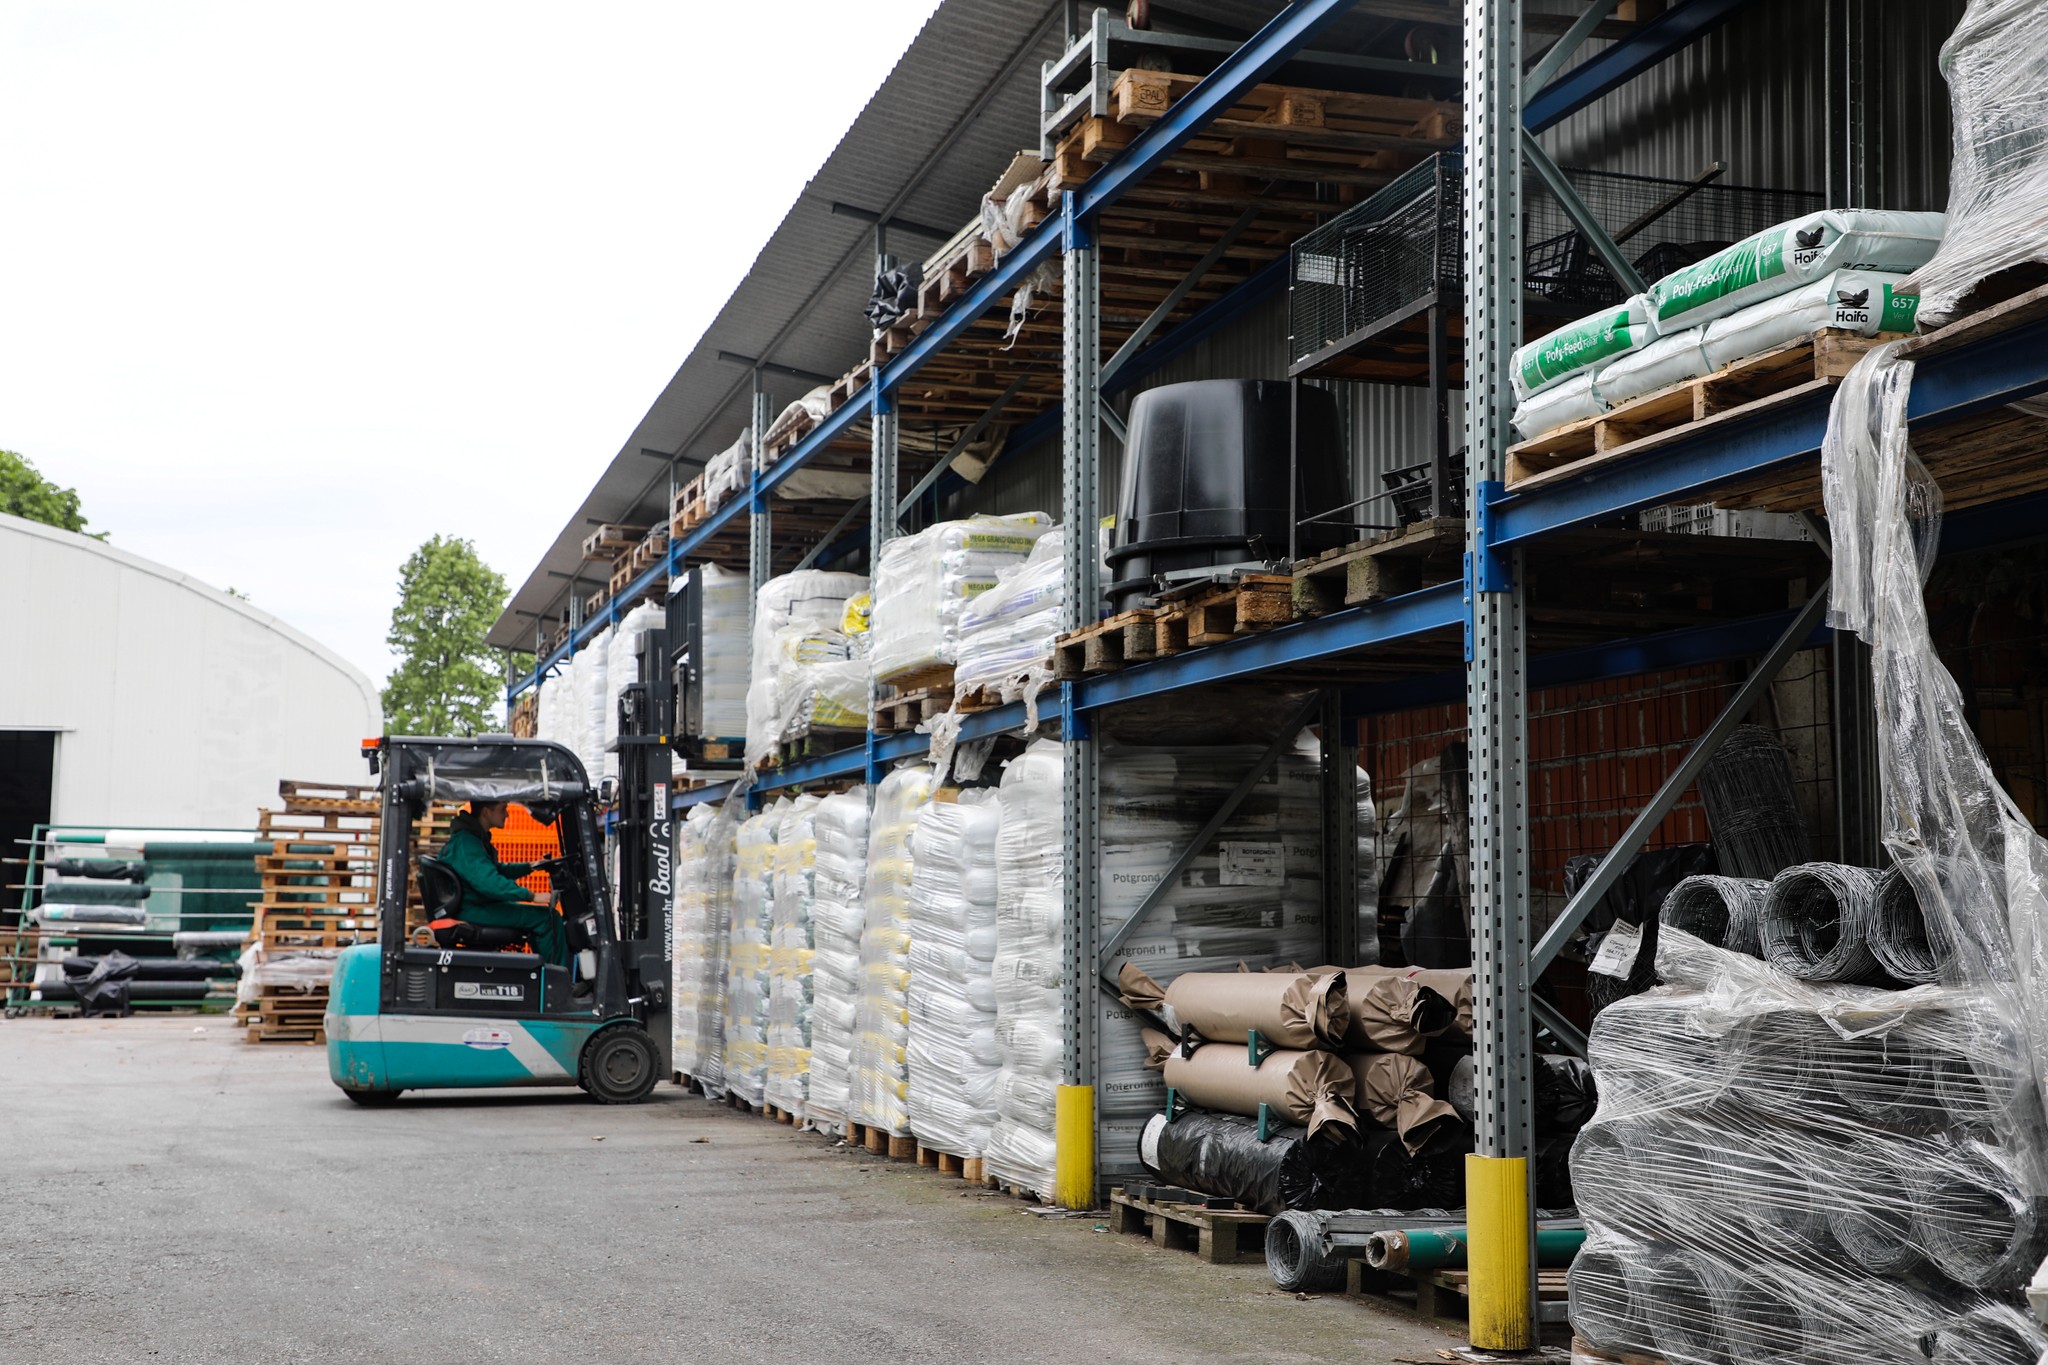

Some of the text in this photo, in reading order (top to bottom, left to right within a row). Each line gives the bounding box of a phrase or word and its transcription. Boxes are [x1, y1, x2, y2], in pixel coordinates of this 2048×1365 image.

[1891, 297, 1915, 309] 657
[1836, 310, 1869, 323] Haifa
[1545, 336, 1583, 364] Poly-Feed
[649, 842, 671, 896] Baoli
[1113, 873, 1160, 885] Potgrond
[662, 898, 672, 962] www.var.hr
[1114, 945, 1154, 957] otgrond
[437, 951, 453, 965] 18
[1106, 1009, 1138, 1020] Potgr
